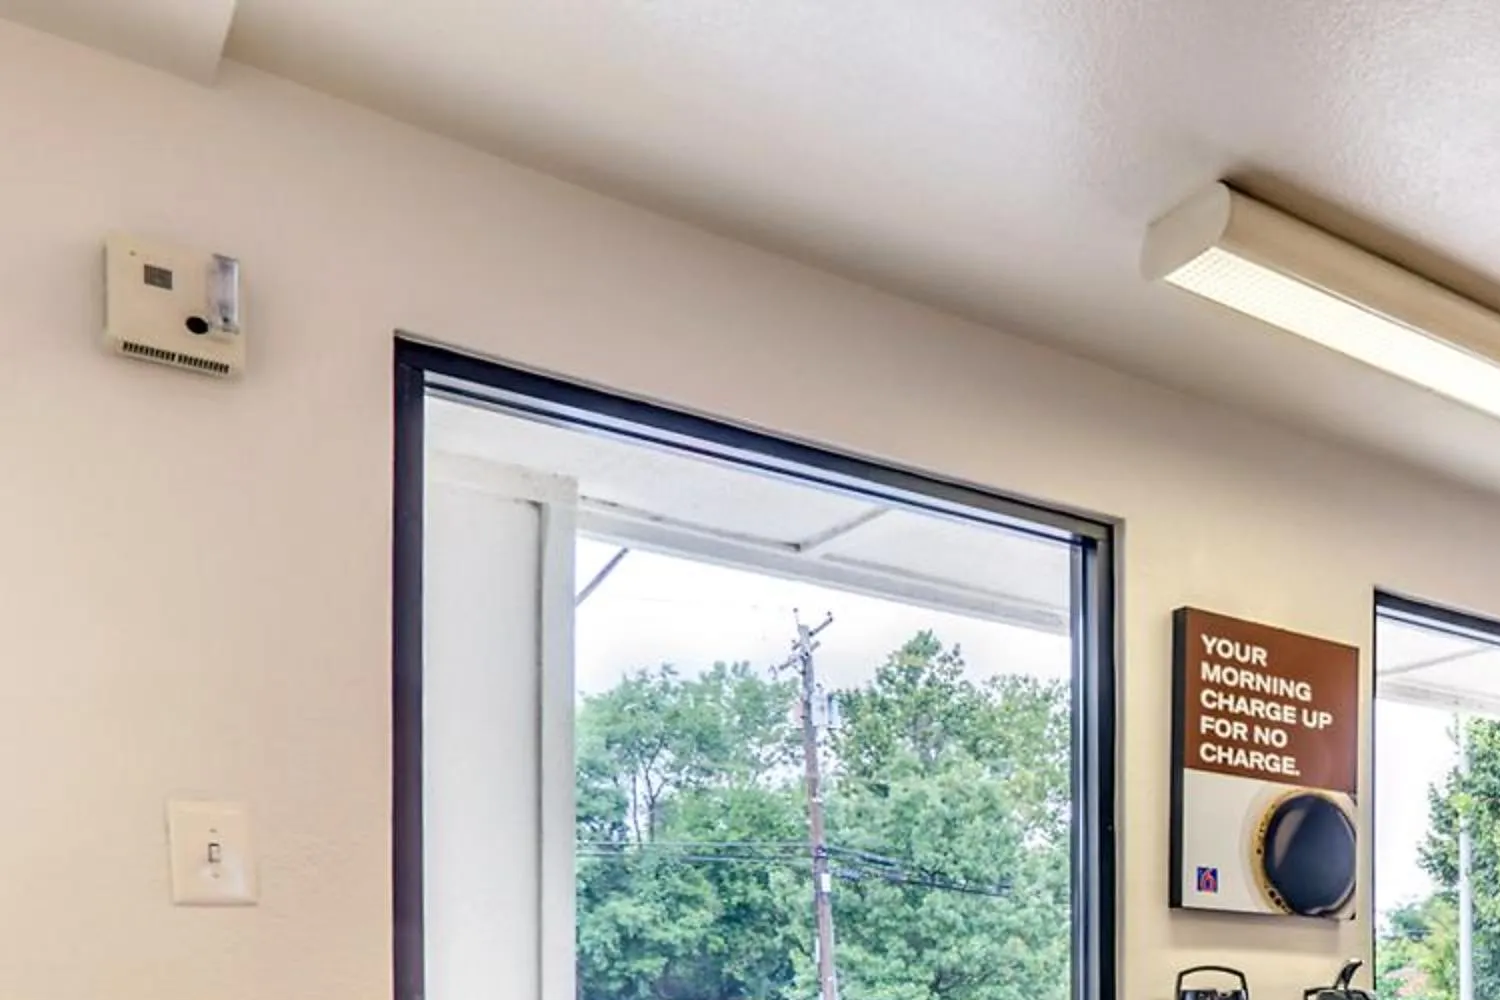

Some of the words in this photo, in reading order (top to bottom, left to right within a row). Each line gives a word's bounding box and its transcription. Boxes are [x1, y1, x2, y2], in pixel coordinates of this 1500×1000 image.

[1201, 633, 1268, 667] YOUR
[1201, 660, 1312, 702] MORNING
[1200, 688, 1297, 724] CHARGE
[1301, 708, 1333, 729] UP
[1200, 715, 1248, 741] FOR
[1253, 725, 1288, 748] NO
[1199, 742, 1301, 776] CHARGE.
